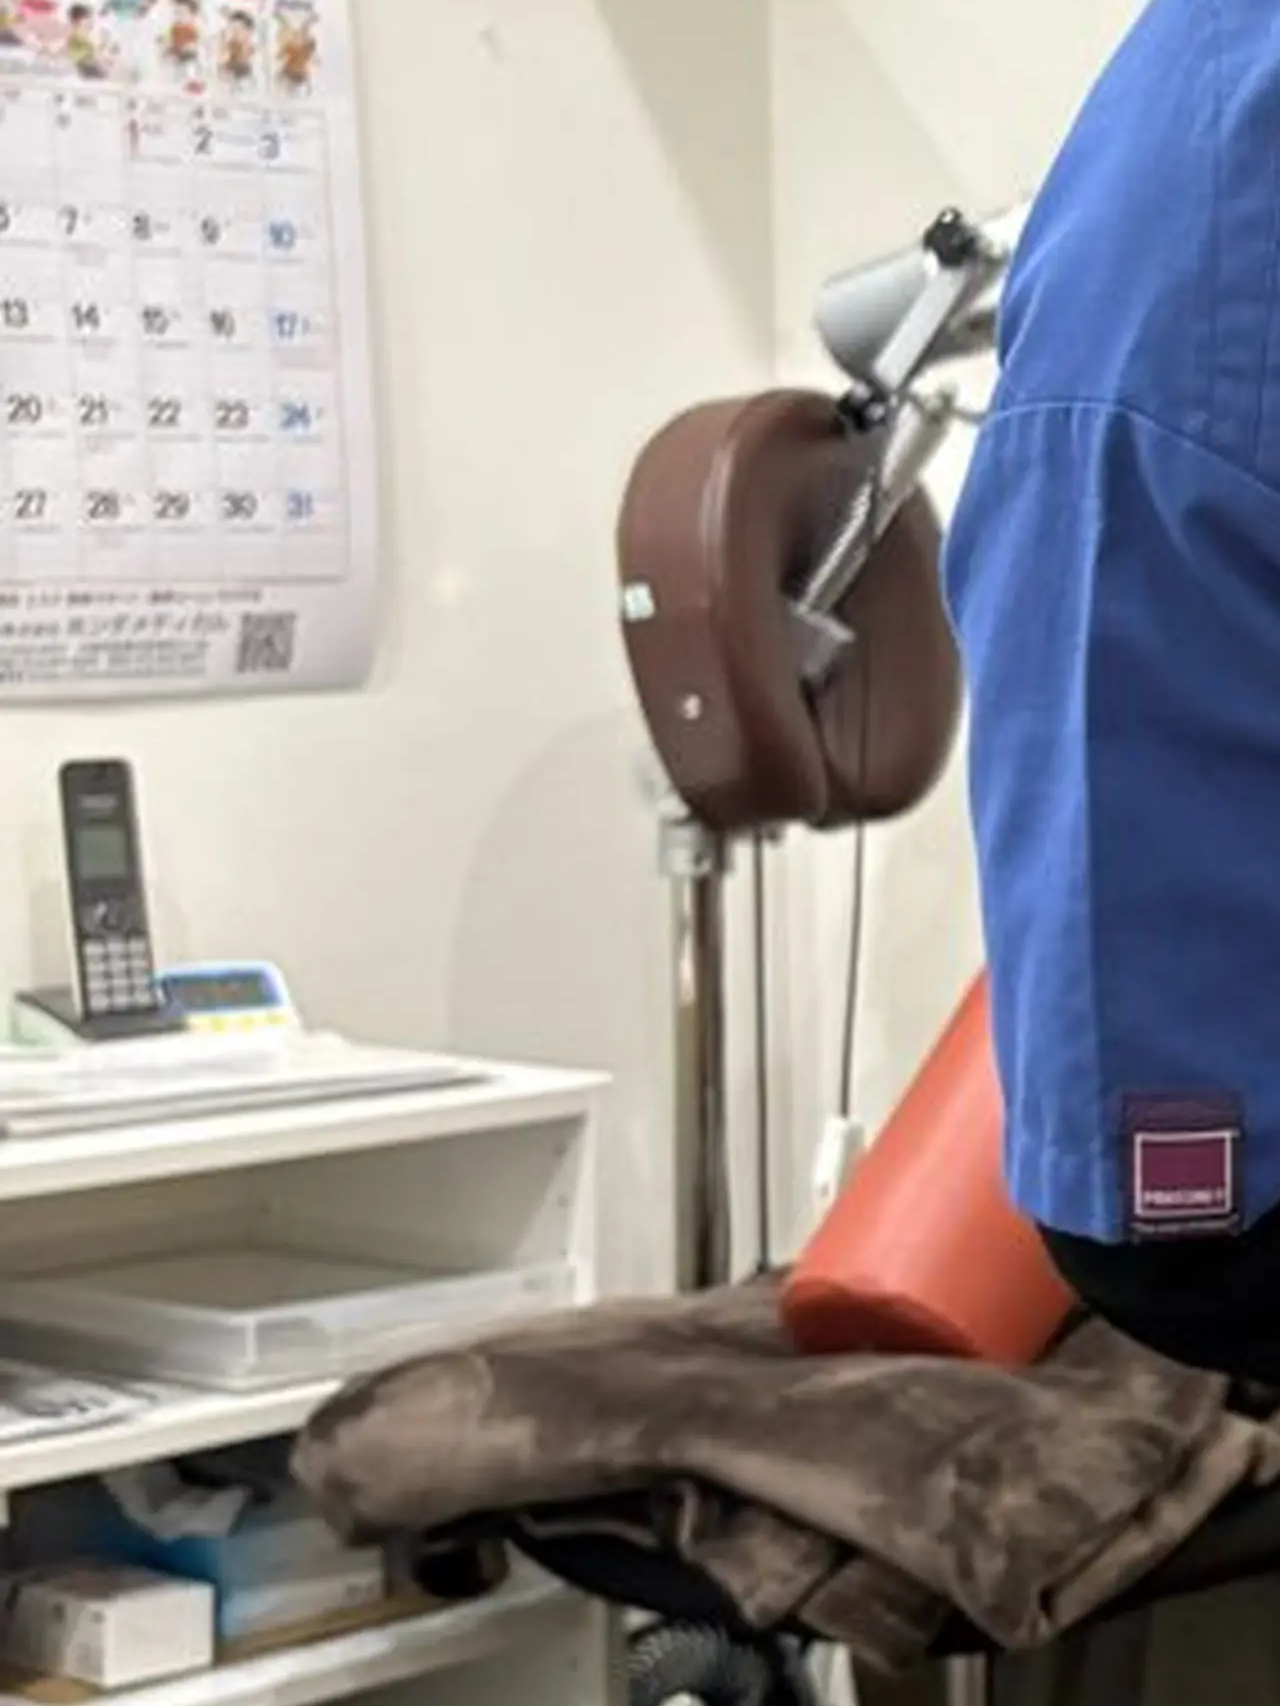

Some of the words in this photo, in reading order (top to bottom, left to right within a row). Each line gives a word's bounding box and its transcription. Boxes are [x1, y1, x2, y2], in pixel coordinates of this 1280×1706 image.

[194, 124, 213, 155] 2
[258, 131, 281, 161] 3
[58, 204, 78, 235] 7
[72, 300, 100, 330] 14
[143, 304, 169, 335] 15
[6, 393, 43, 425] 20
[79, 393, 109, 427] 21
[148, 396, 182, 428] 22
[215, 399, 250, 430] 23
[281, 400, 312, 431] 24
[14, 488, 47, 520] 27
[85, 488, 120, 520] 28
[154, 489, 191, 520] 29
[222, 489, 259, 521] 30
[287, 487, 315, 520] 31
